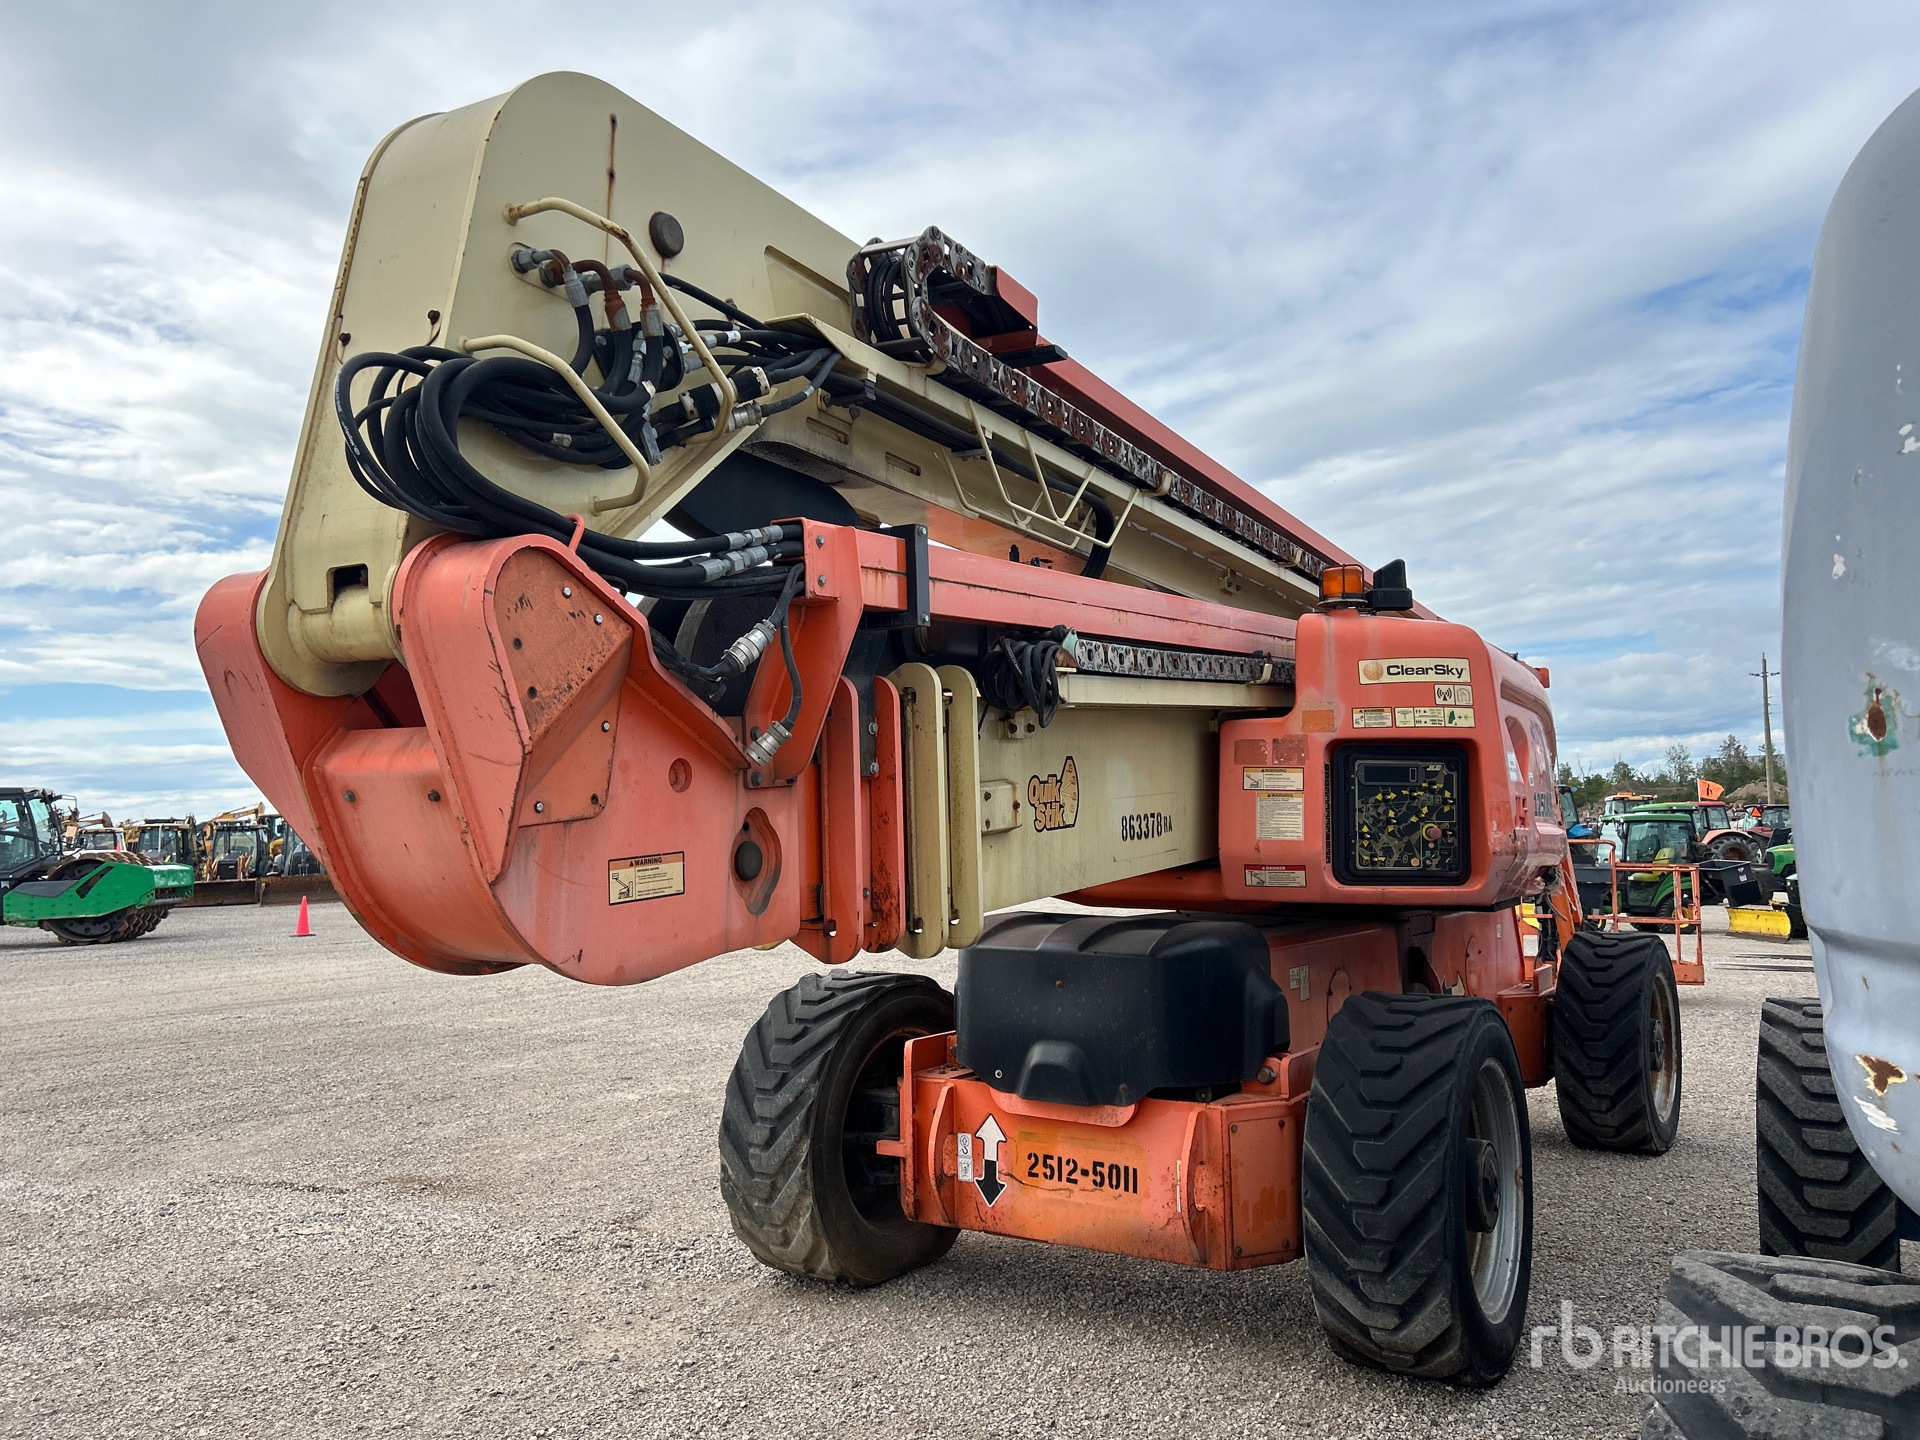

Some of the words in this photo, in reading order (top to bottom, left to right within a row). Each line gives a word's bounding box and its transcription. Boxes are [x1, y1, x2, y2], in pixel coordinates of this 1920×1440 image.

[1387, 664, 1464, 678] ClearSky
[1028, 776, 1061, 807] Quik
[1035, 802, 1064, 830] Stik
[635, 857, 662, 866] WARNING
[1027, 1152, 1138, 1194] 2512-5011
